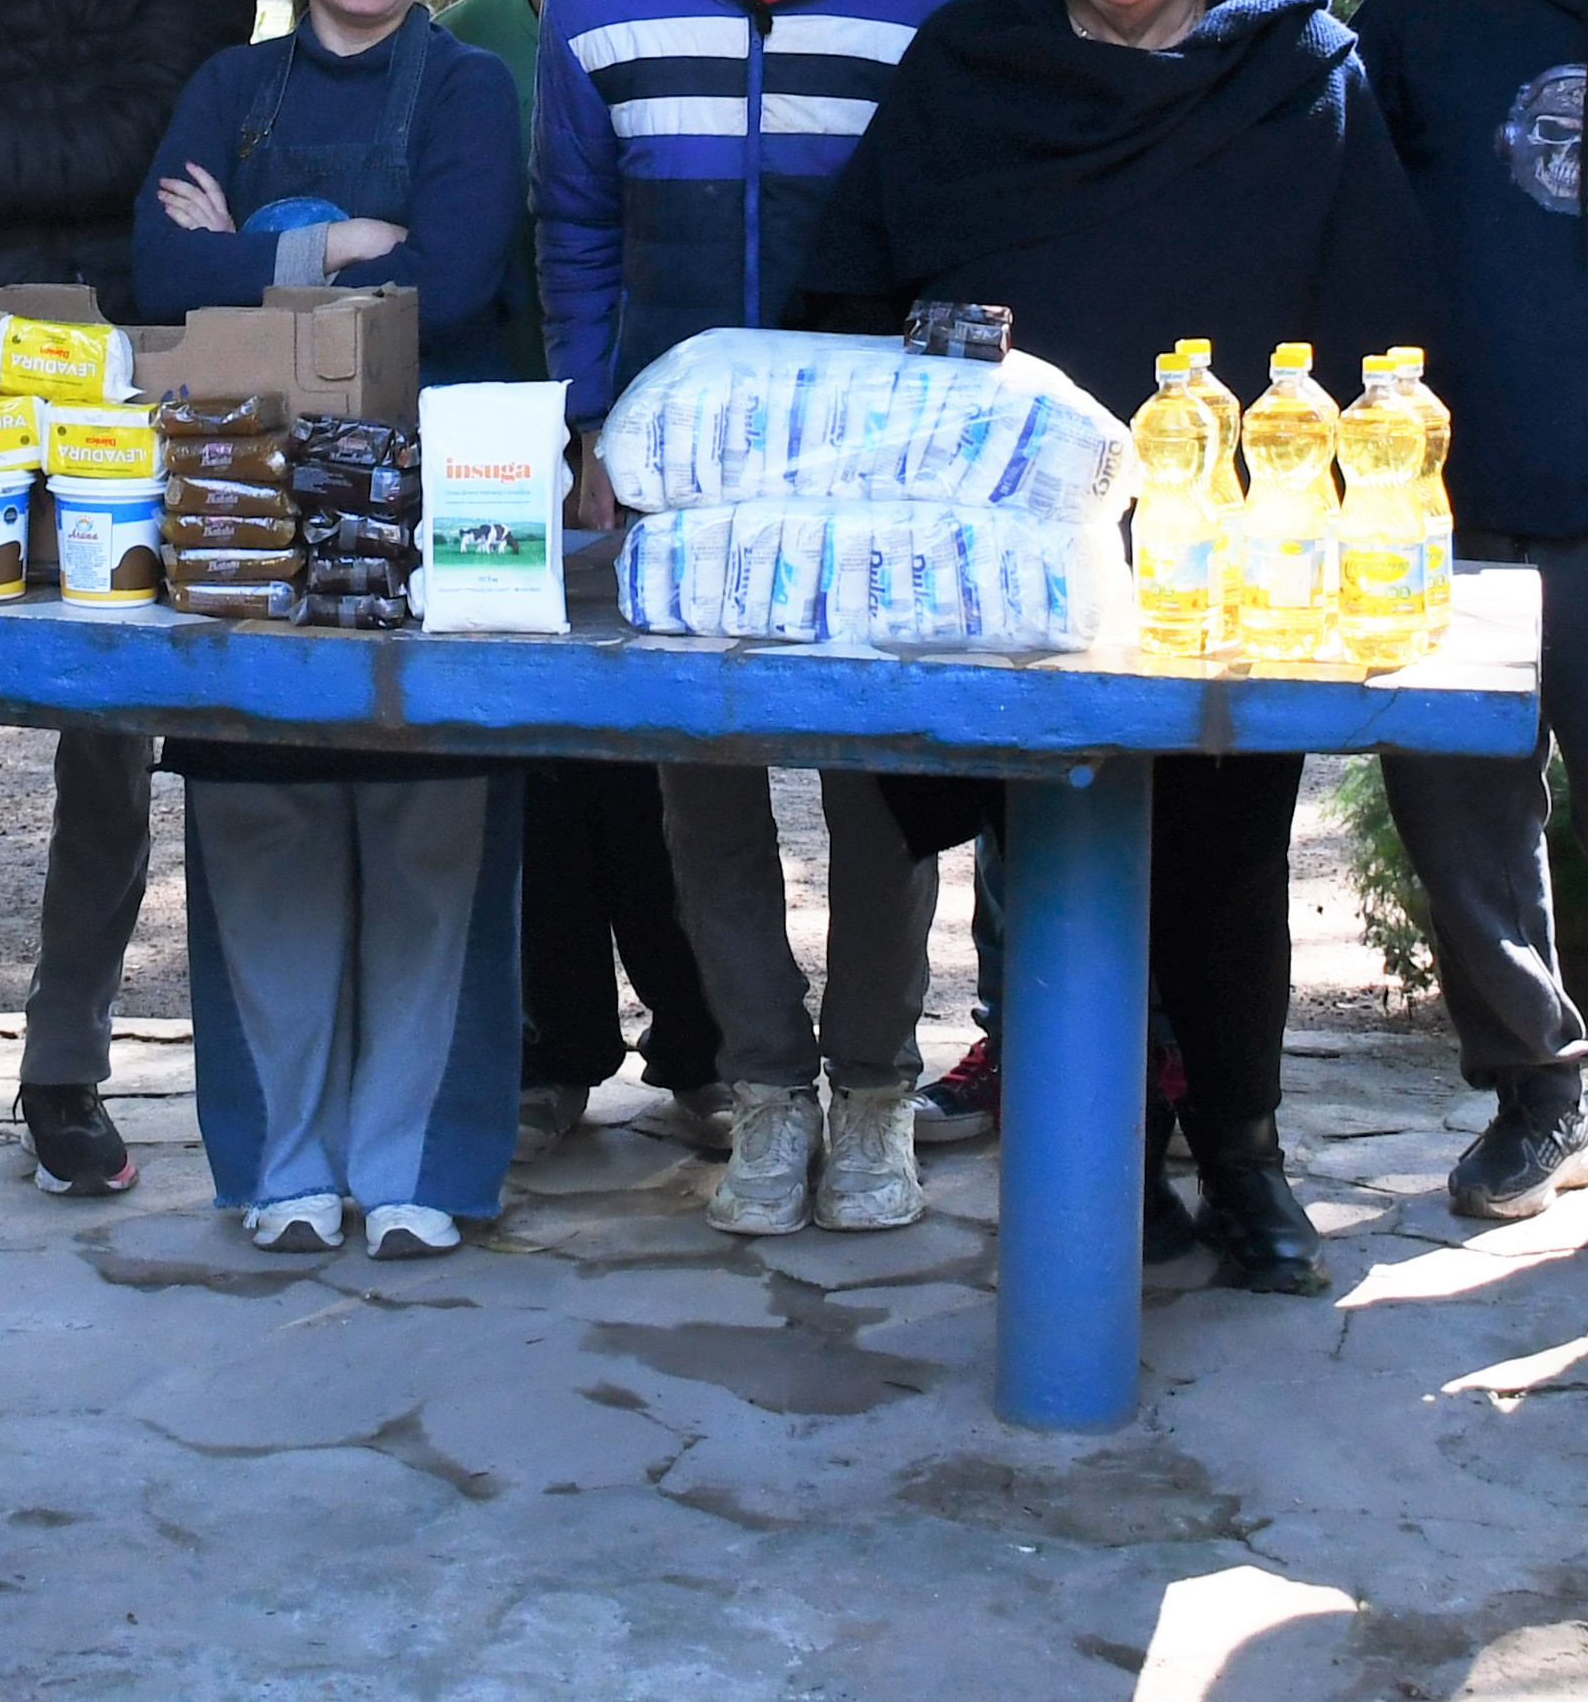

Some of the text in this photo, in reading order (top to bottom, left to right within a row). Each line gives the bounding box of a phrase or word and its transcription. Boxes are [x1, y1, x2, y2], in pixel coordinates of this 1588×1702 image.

[10, 351, 97, 378] LEVADURA
[58, 445, 147, 463] LEVADURA
[445, 457, 532, 486] insuga
[1091, 439, 1124, 503] Dulcy
[869, 549, 886, 619] Dulcy
